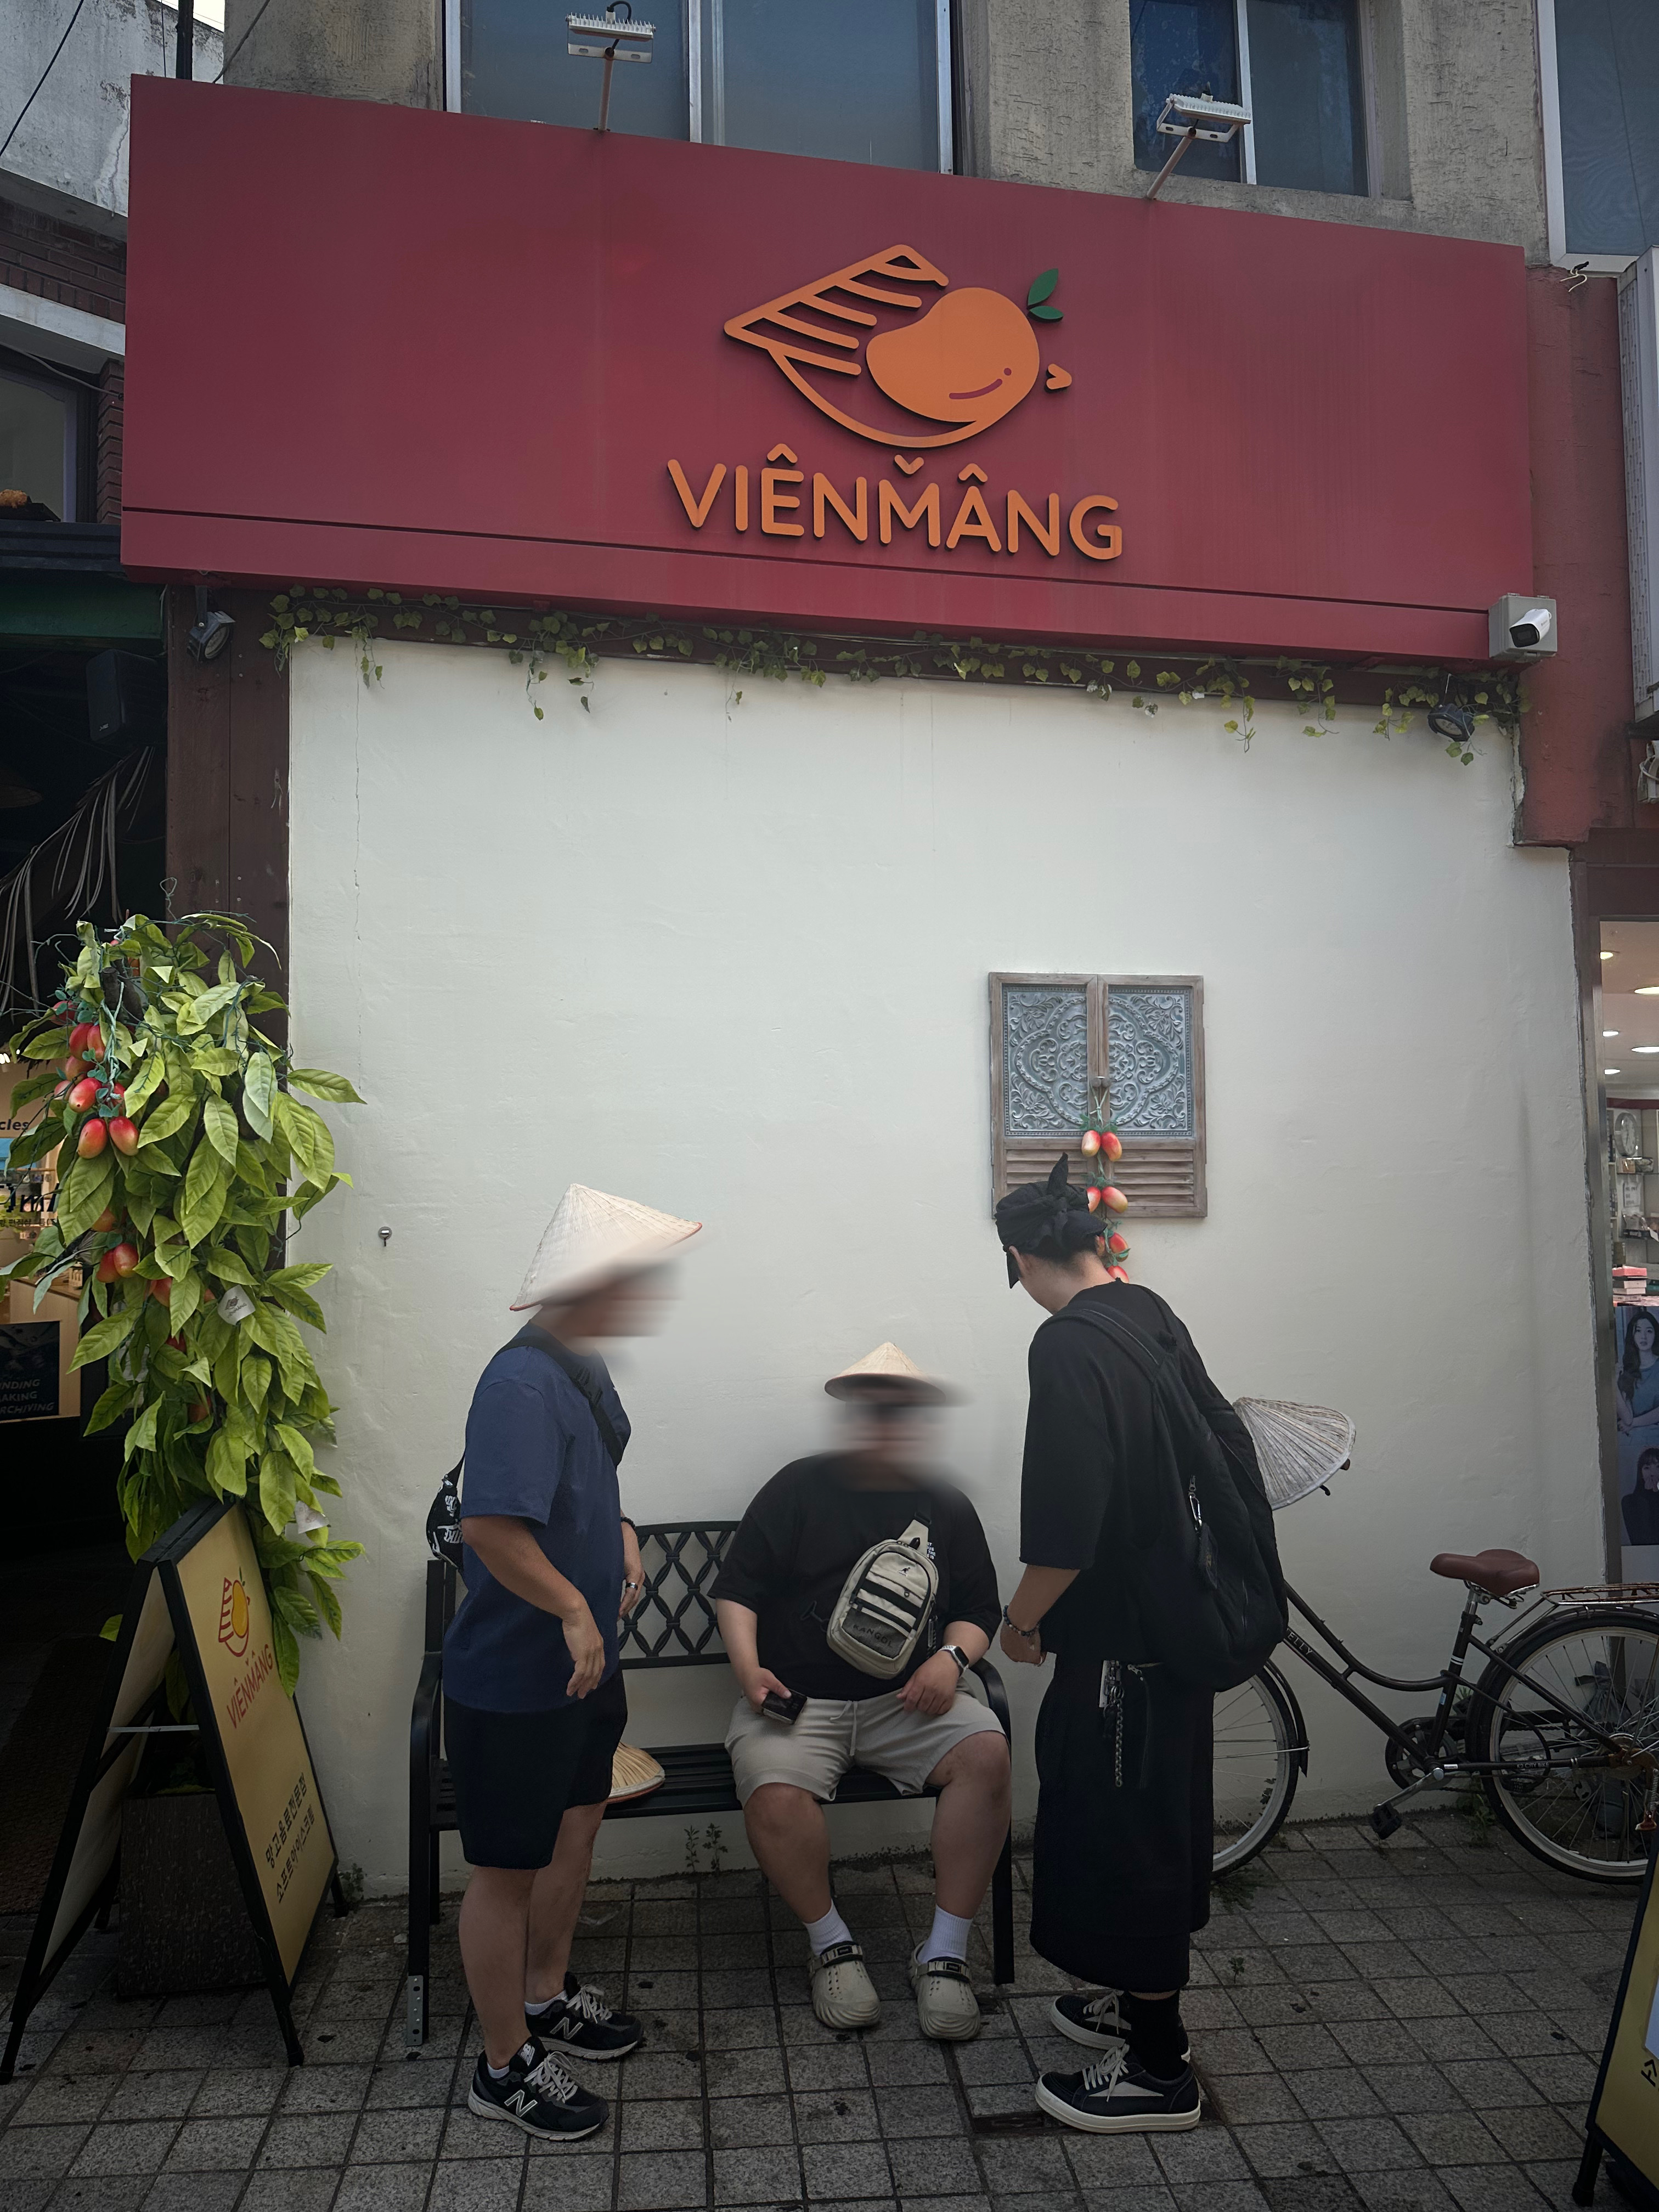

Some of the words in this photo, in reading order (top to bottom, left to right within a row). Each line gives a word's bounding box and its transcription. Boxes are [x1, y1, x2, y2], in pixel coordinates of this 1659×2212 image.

[0, 1391, 38, 1402] AKING
[853, 1624, 893, 1647] KANGOL
[1286, 1628, 1313, 1655] ELLY
[265, 1771, 307, 1869] 망고음료전문점
[276, 1803, 315, 1904] 소프트아이스크림
